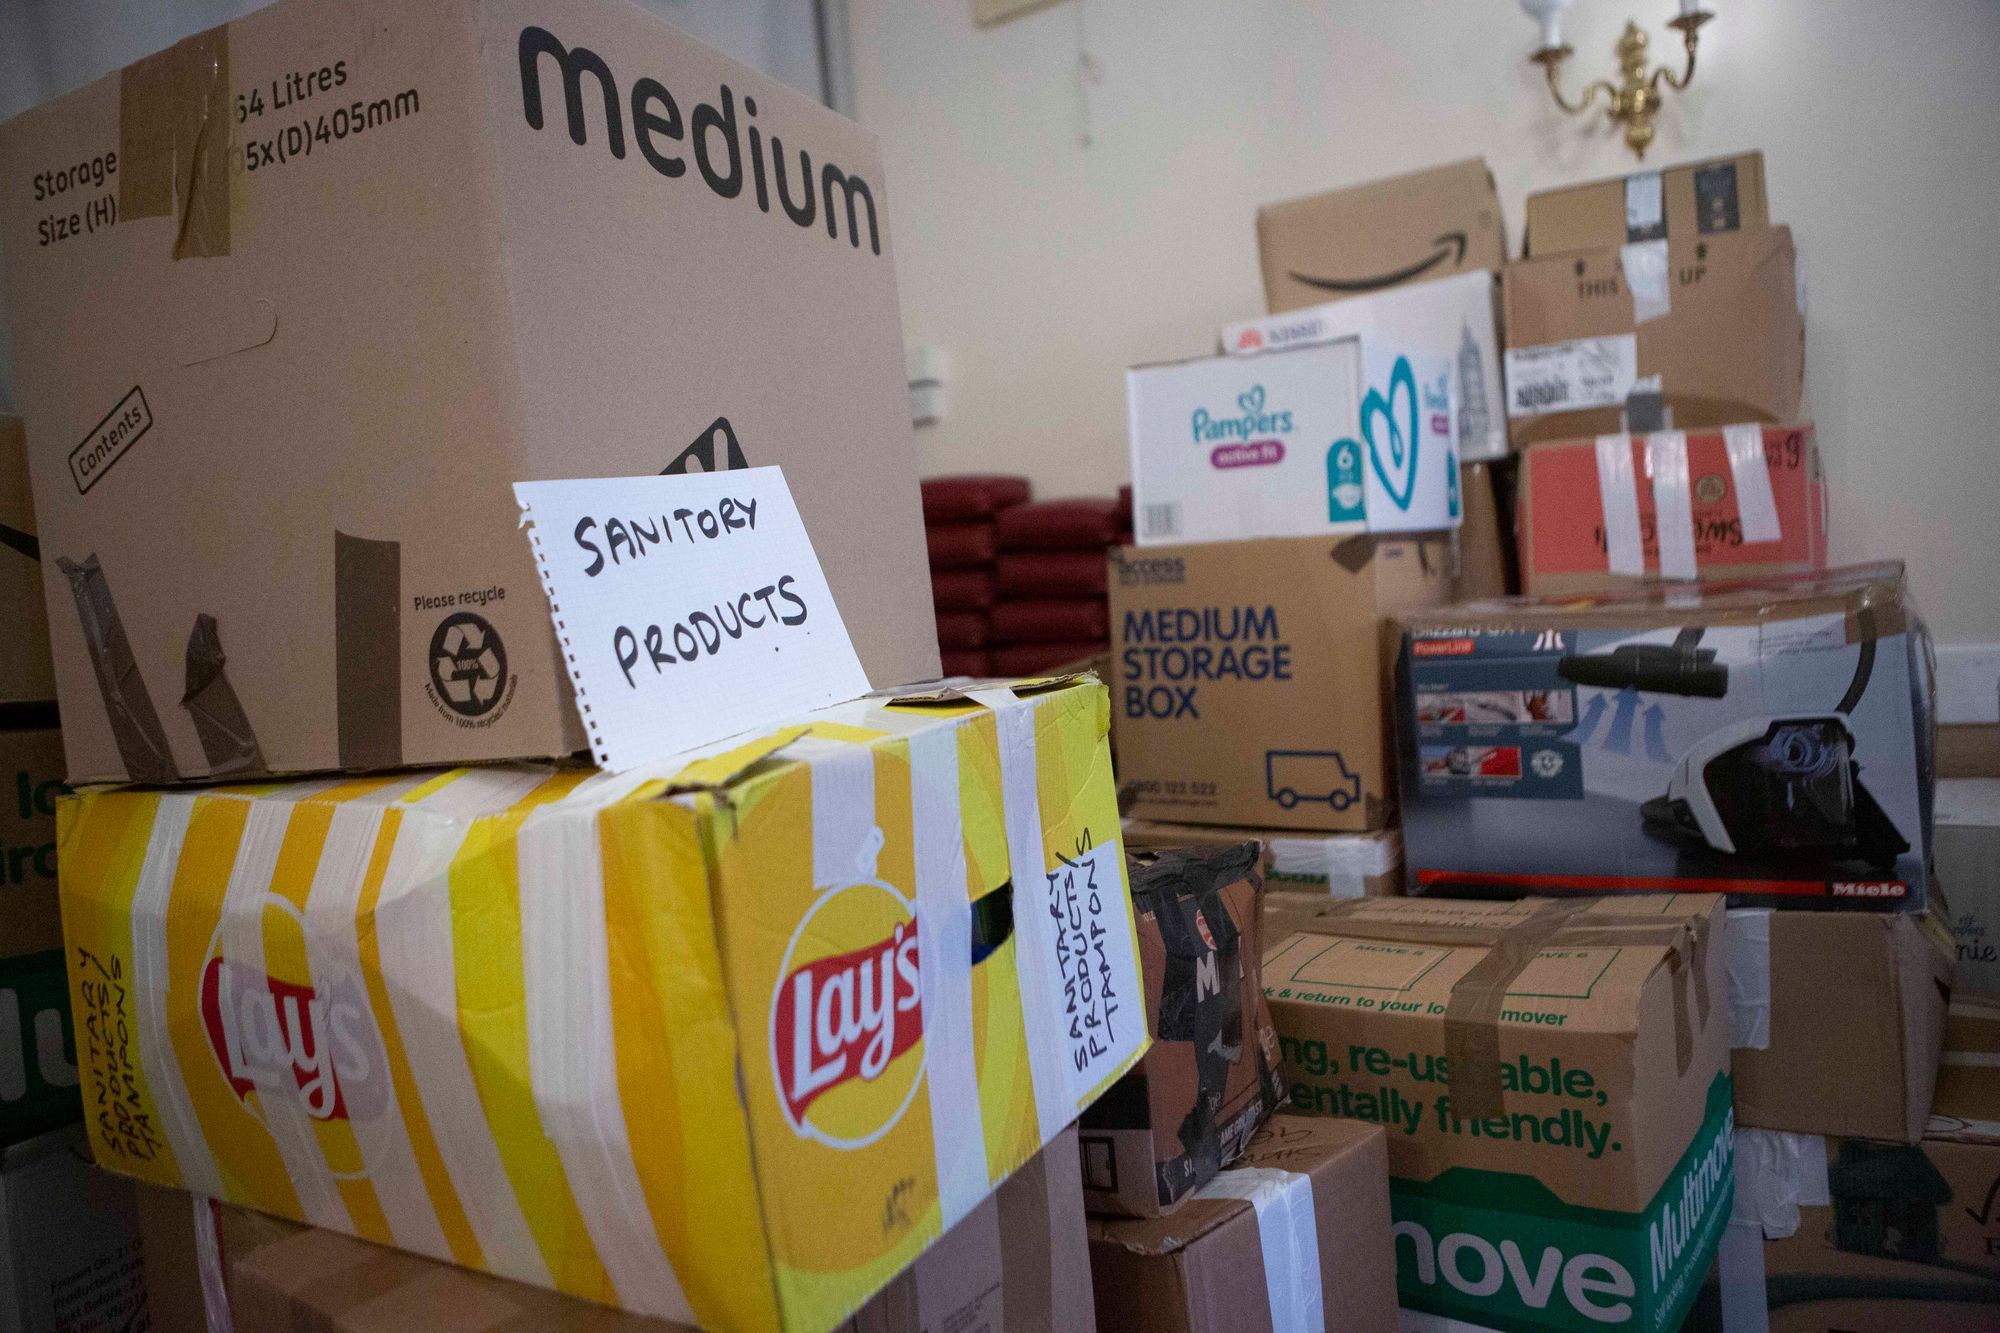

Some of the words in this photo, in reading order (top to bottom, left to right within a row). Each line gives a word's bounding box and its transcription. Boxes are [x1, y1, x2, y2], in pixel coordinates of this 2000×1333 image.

[272, 59, 347, 111] Litres
[518, 25, 881, 257] medium
[33, 150, 118, 202] Storage
[37, 204, 81, 248] Size
[84, 192, 118, 235] (H)
[78, 405, 143, 477] Contents
[1193, 406, 1293, 443] Pampers
[1337, 445, 1355, 471] 6
[573, 496, 758, 578] SANITORY
[413, 594, 456, 610] Please
[458, 585, 506, 606] recycle
[613, 574, 809, 688] PRODUCTS
[1123, 604, 1279, 644] MEDIUM
[1123, 644, 1292, 682] STORAGE
[1125, 686, 1200, 720] BOX
[1832, 883, 1906, 896] Miele
[792, 922, 921, 1102] Lay's
[1278, 988, 1294, 1000] &
[1296, 990, 1351, 1005] return
[1356, 995, 1376, 1007] to
[1378, 999, 1421, 1015] your
[1348, 1045, 1608, 1108] re-usable,
[1649, 1105, 1735, 1295] Multimove
